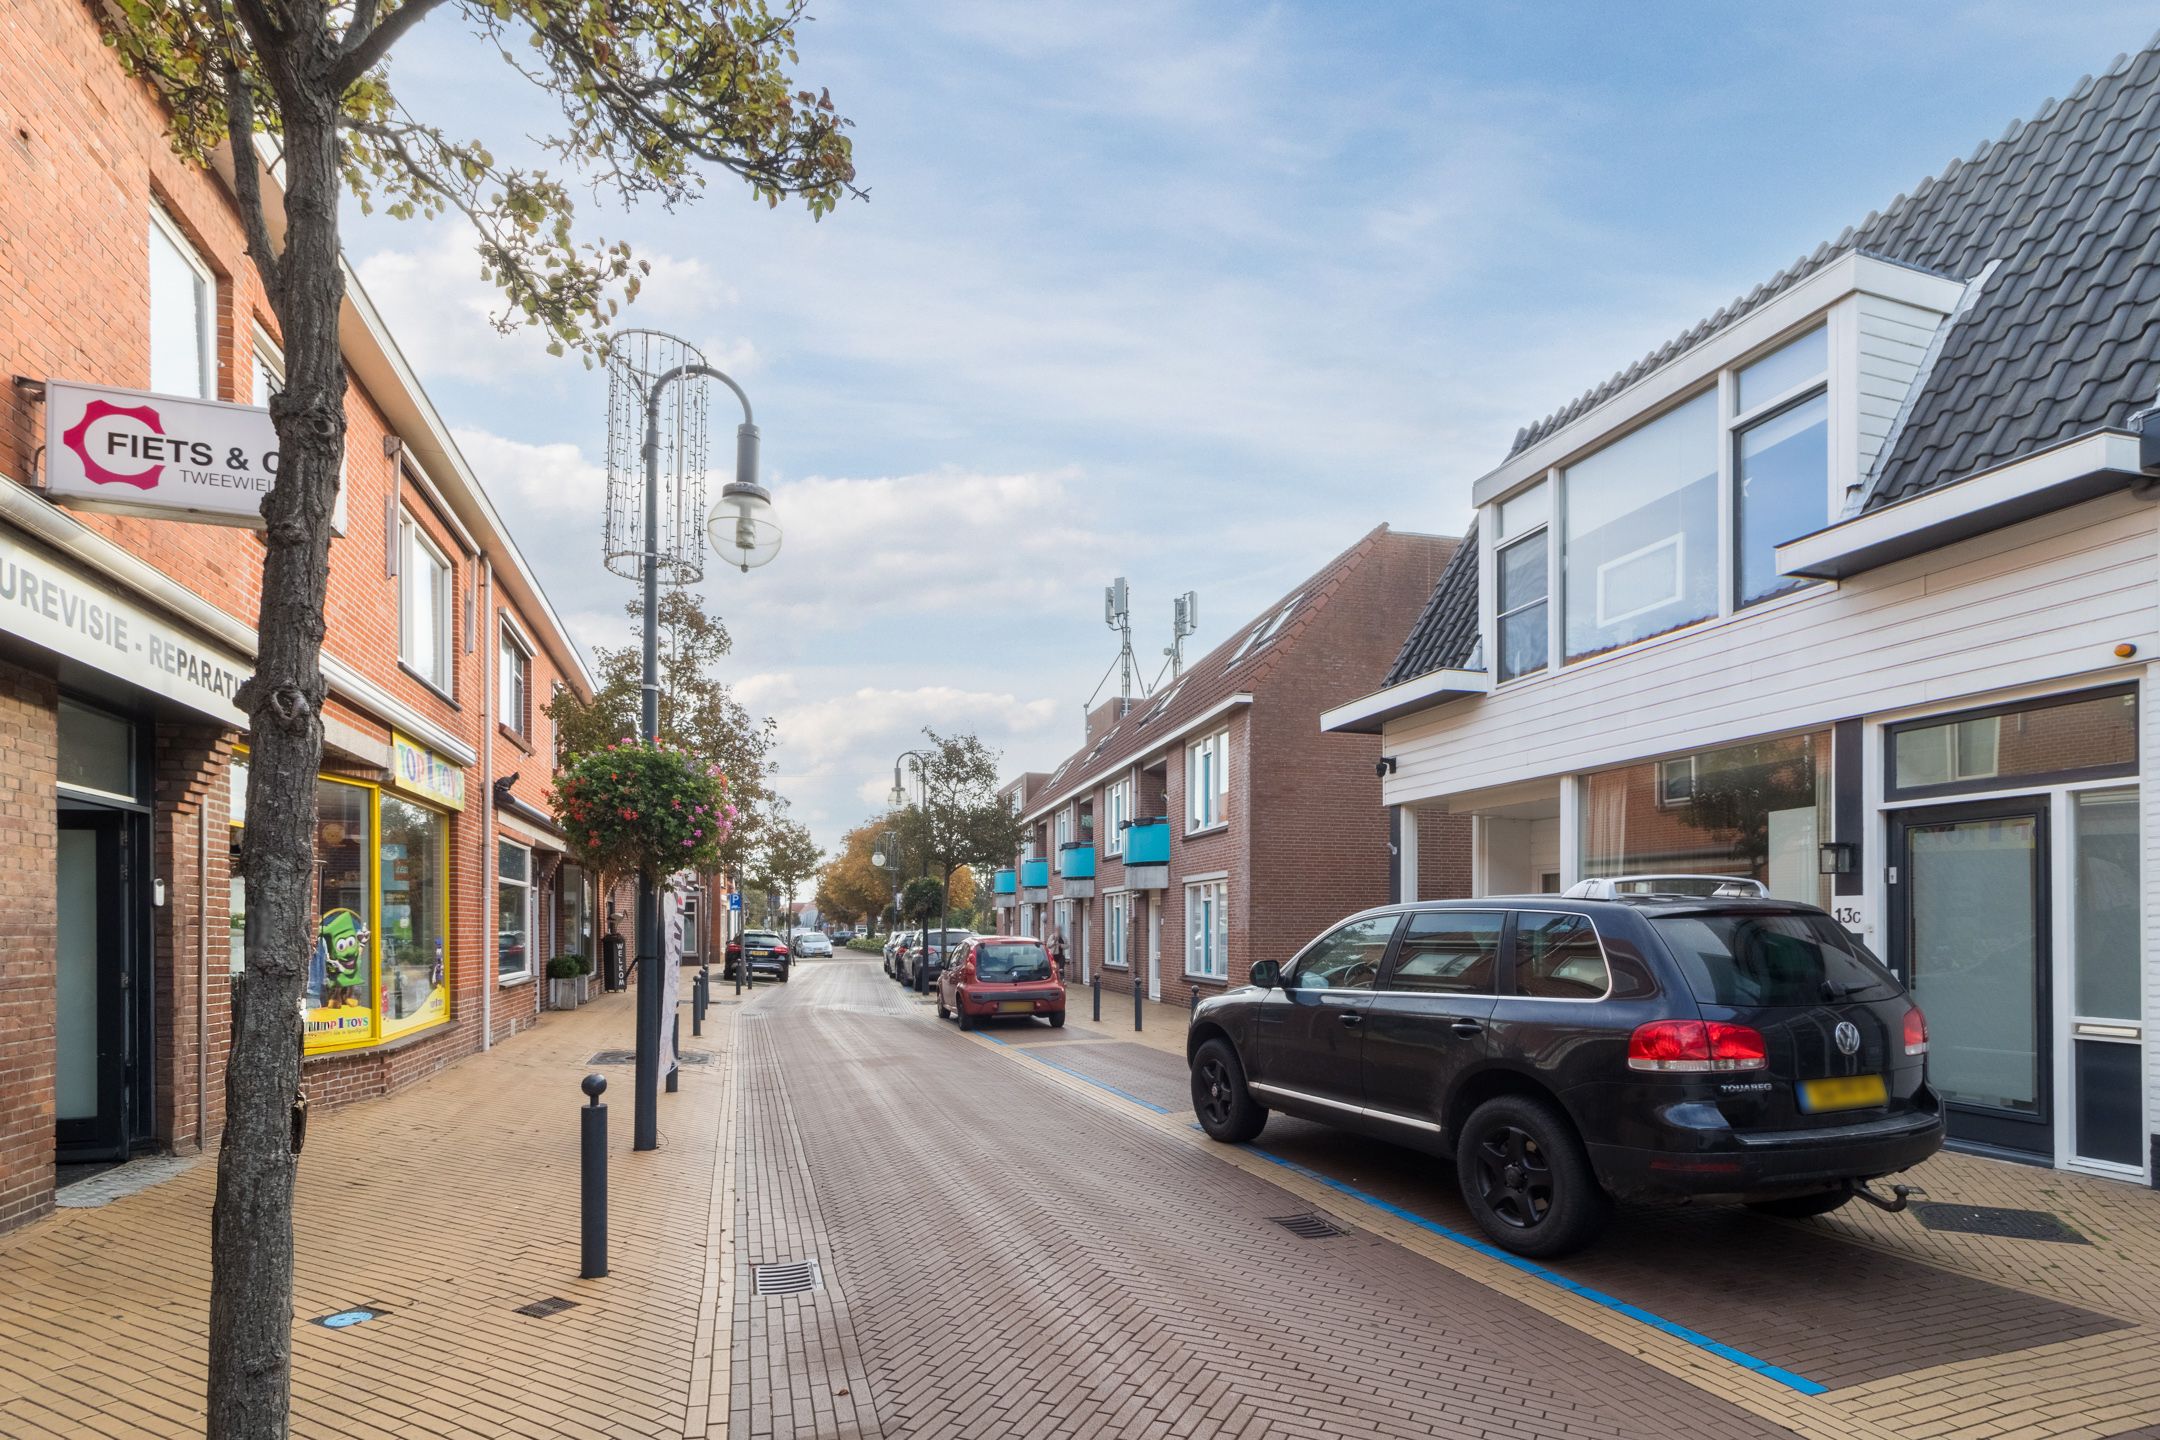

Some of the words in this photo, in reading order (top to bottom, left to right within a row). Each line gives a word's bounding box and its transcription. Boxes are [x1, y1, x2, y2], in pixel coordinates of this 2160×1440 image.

[108, 431, 213, 467] FIETS
[226, 447, 250, 471] &
[149, 633, 245, 700] REPARATI
[397, 743, 425, 784] TOP
[435, 763, 463, 801] TOYS
[732, 894, 740, 904] P
[616, 943, 625, 986] WELKOM
[346, 1017, 369, 1028] TOYS
[1720, 1083, 1773, 1093] TOUAREG
